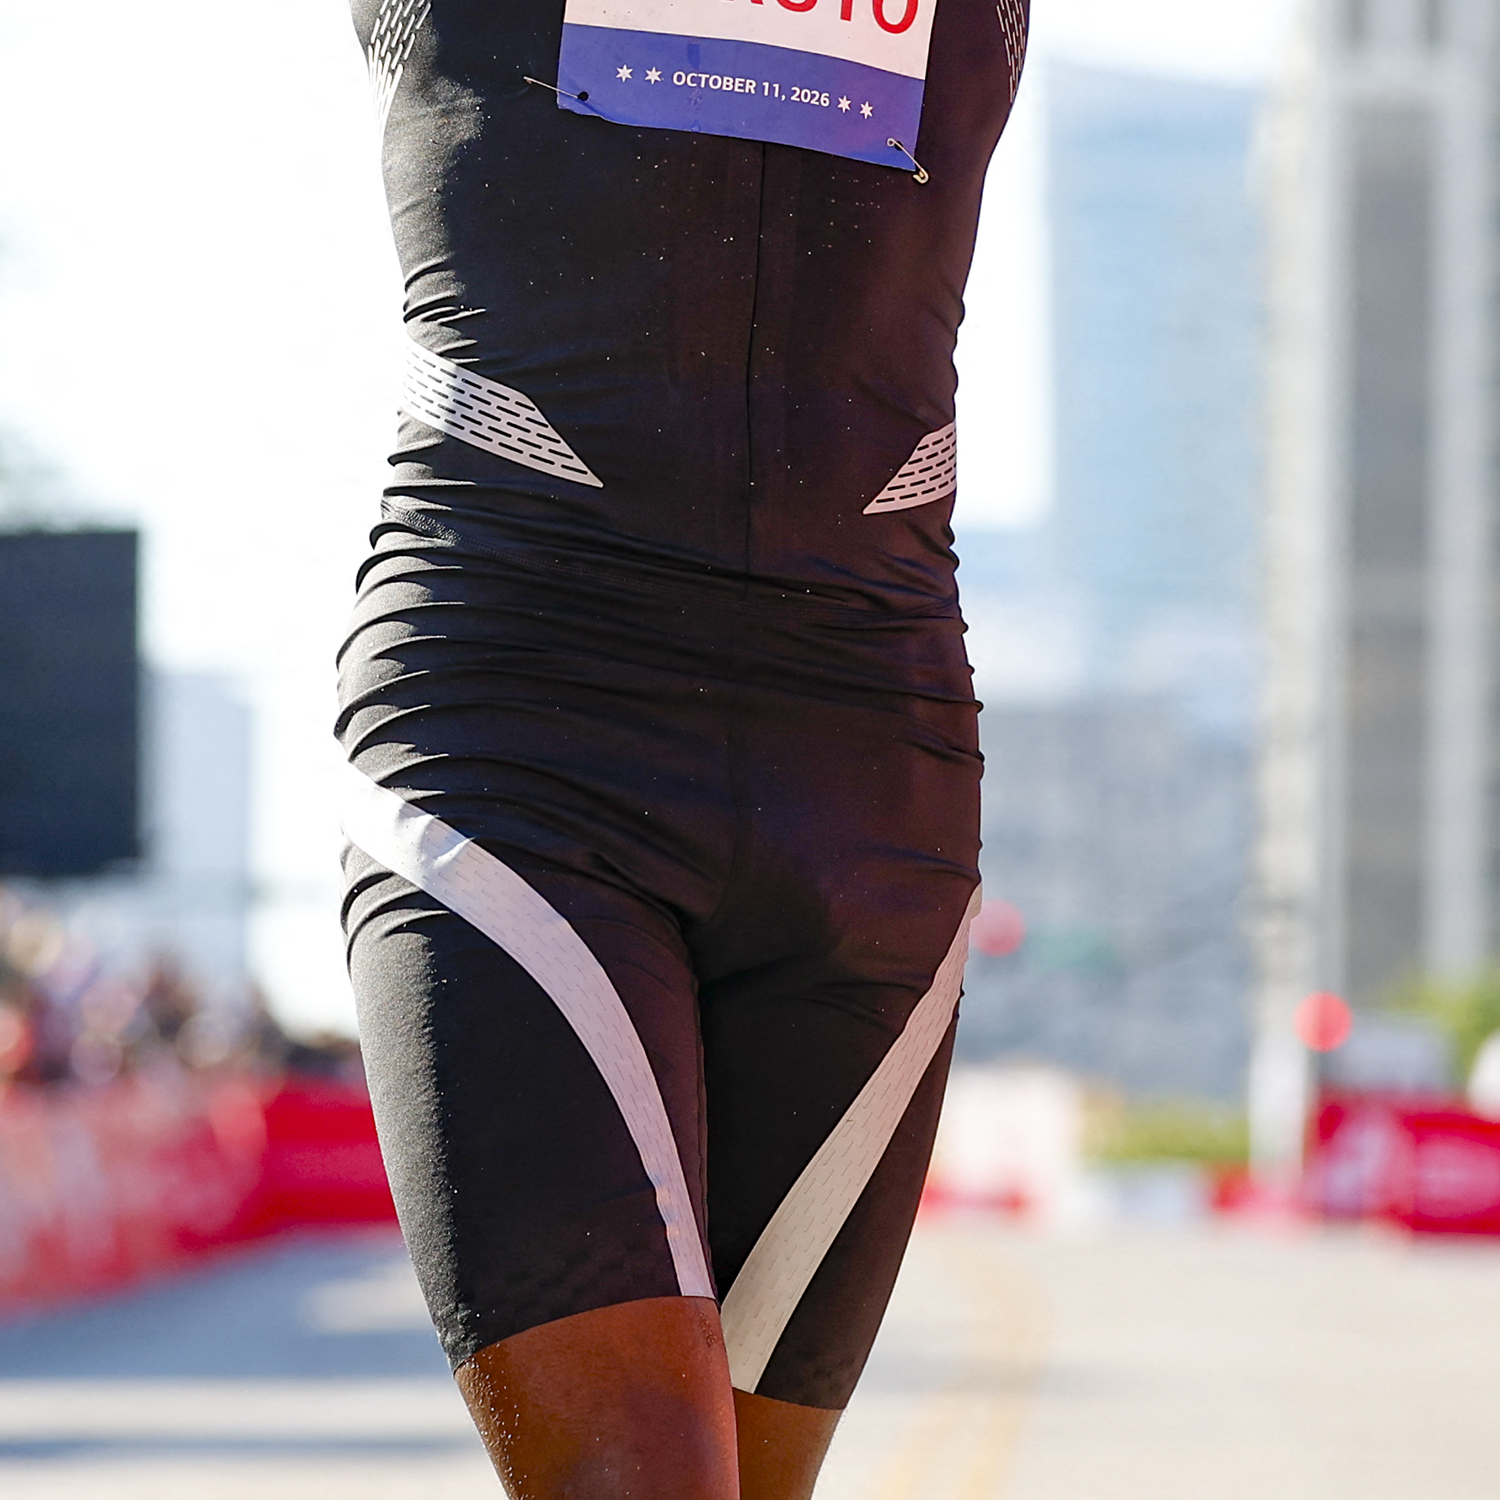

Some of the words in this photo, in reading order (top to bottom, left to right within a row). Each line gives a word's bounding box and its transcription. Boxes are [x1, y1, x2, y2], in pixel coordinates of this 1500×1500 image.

[672, 70, 757, 94] OCTOBER
[762, 81, 787, 101] 11,
[790, 86, 831, 108] 2026
